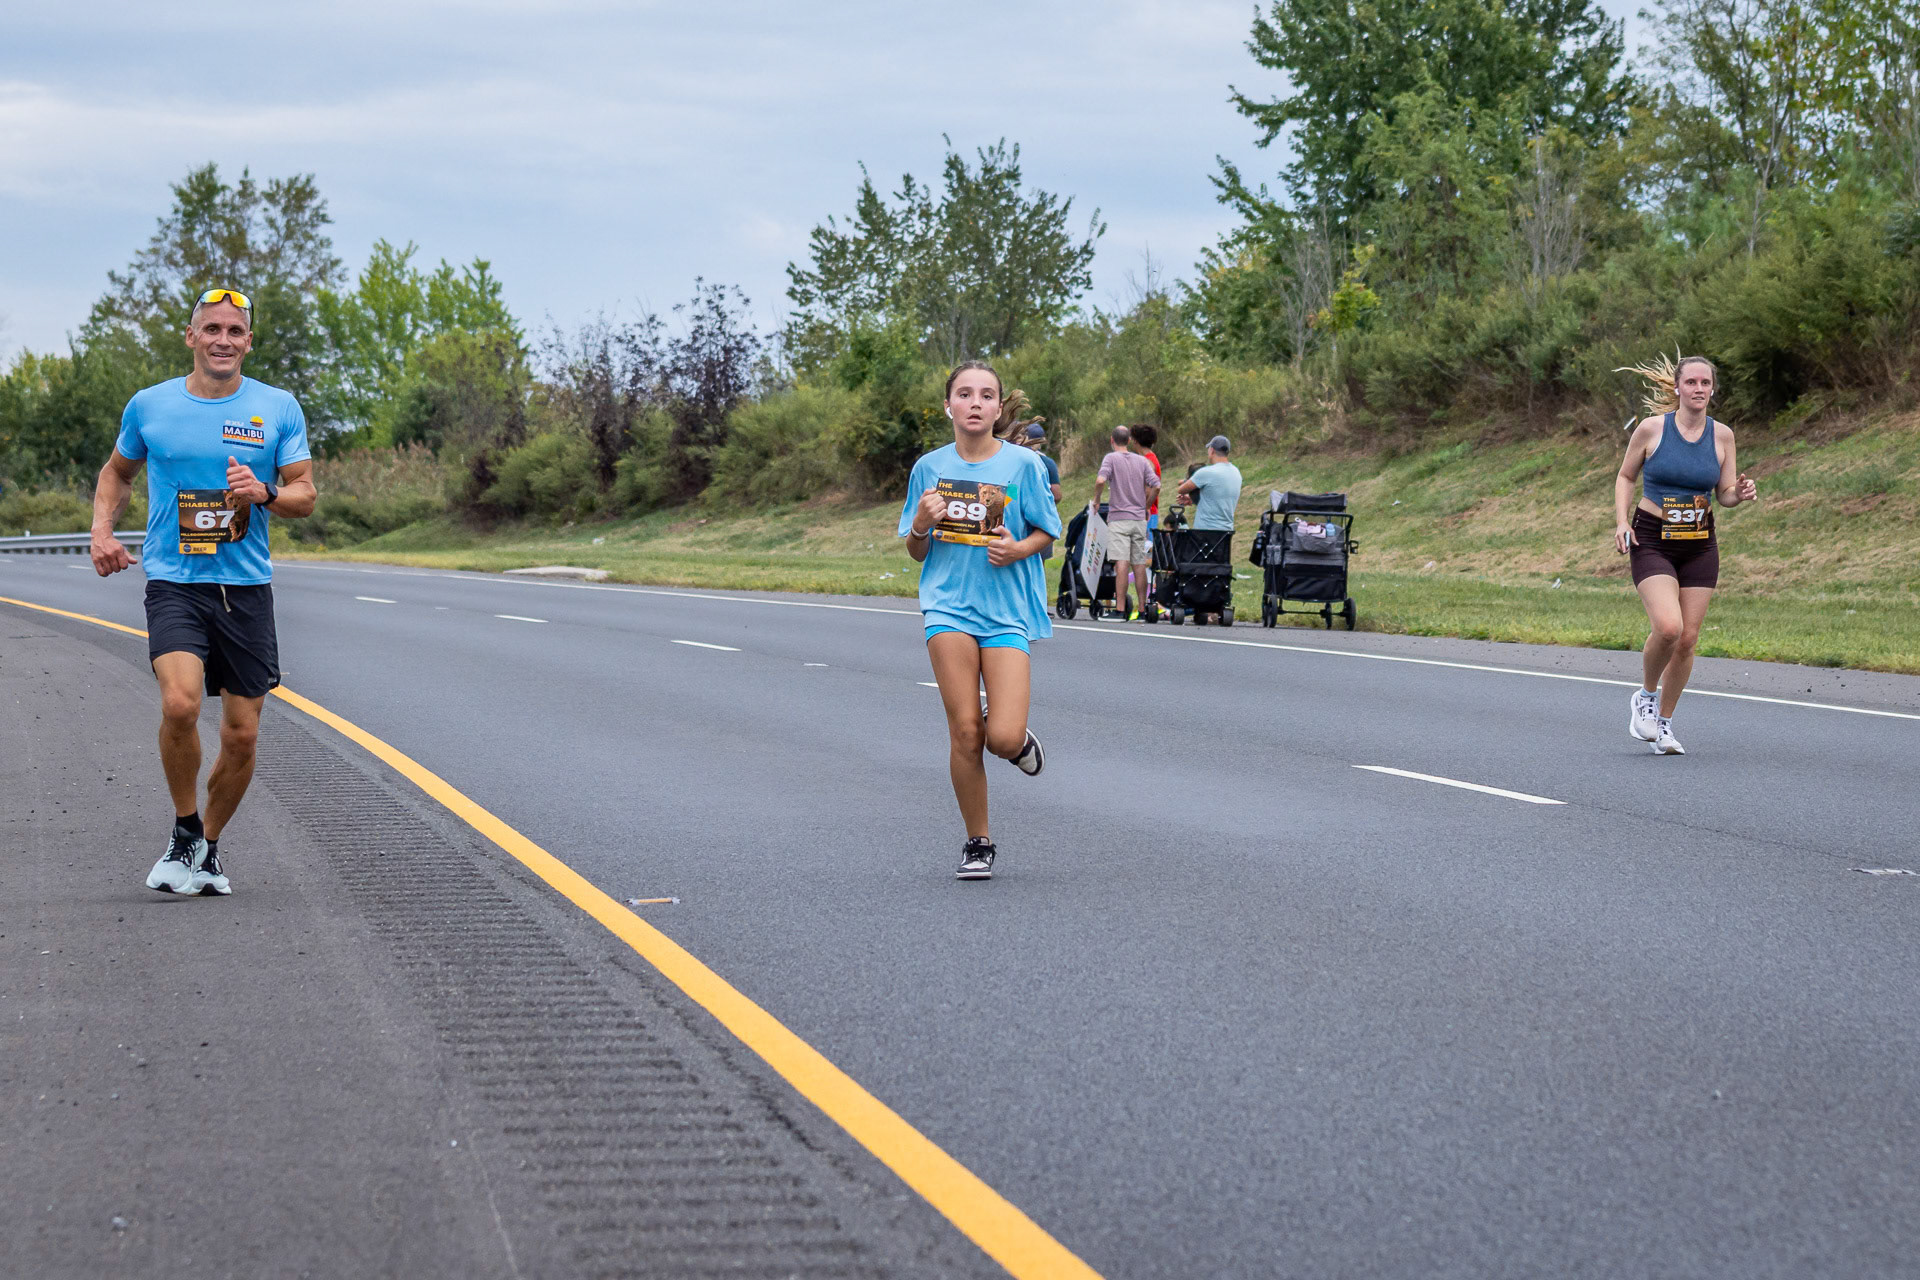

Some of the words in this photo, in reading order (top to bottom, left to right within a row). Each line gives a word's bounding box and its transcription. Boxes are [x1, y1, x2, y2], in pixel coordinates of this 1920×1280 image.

[224, 426, 263, 438] MALIBU
[195, 510, 235, 528] 67
[947, 501, 987, 521] 69
[1667, 509, 1705, 523] 337
